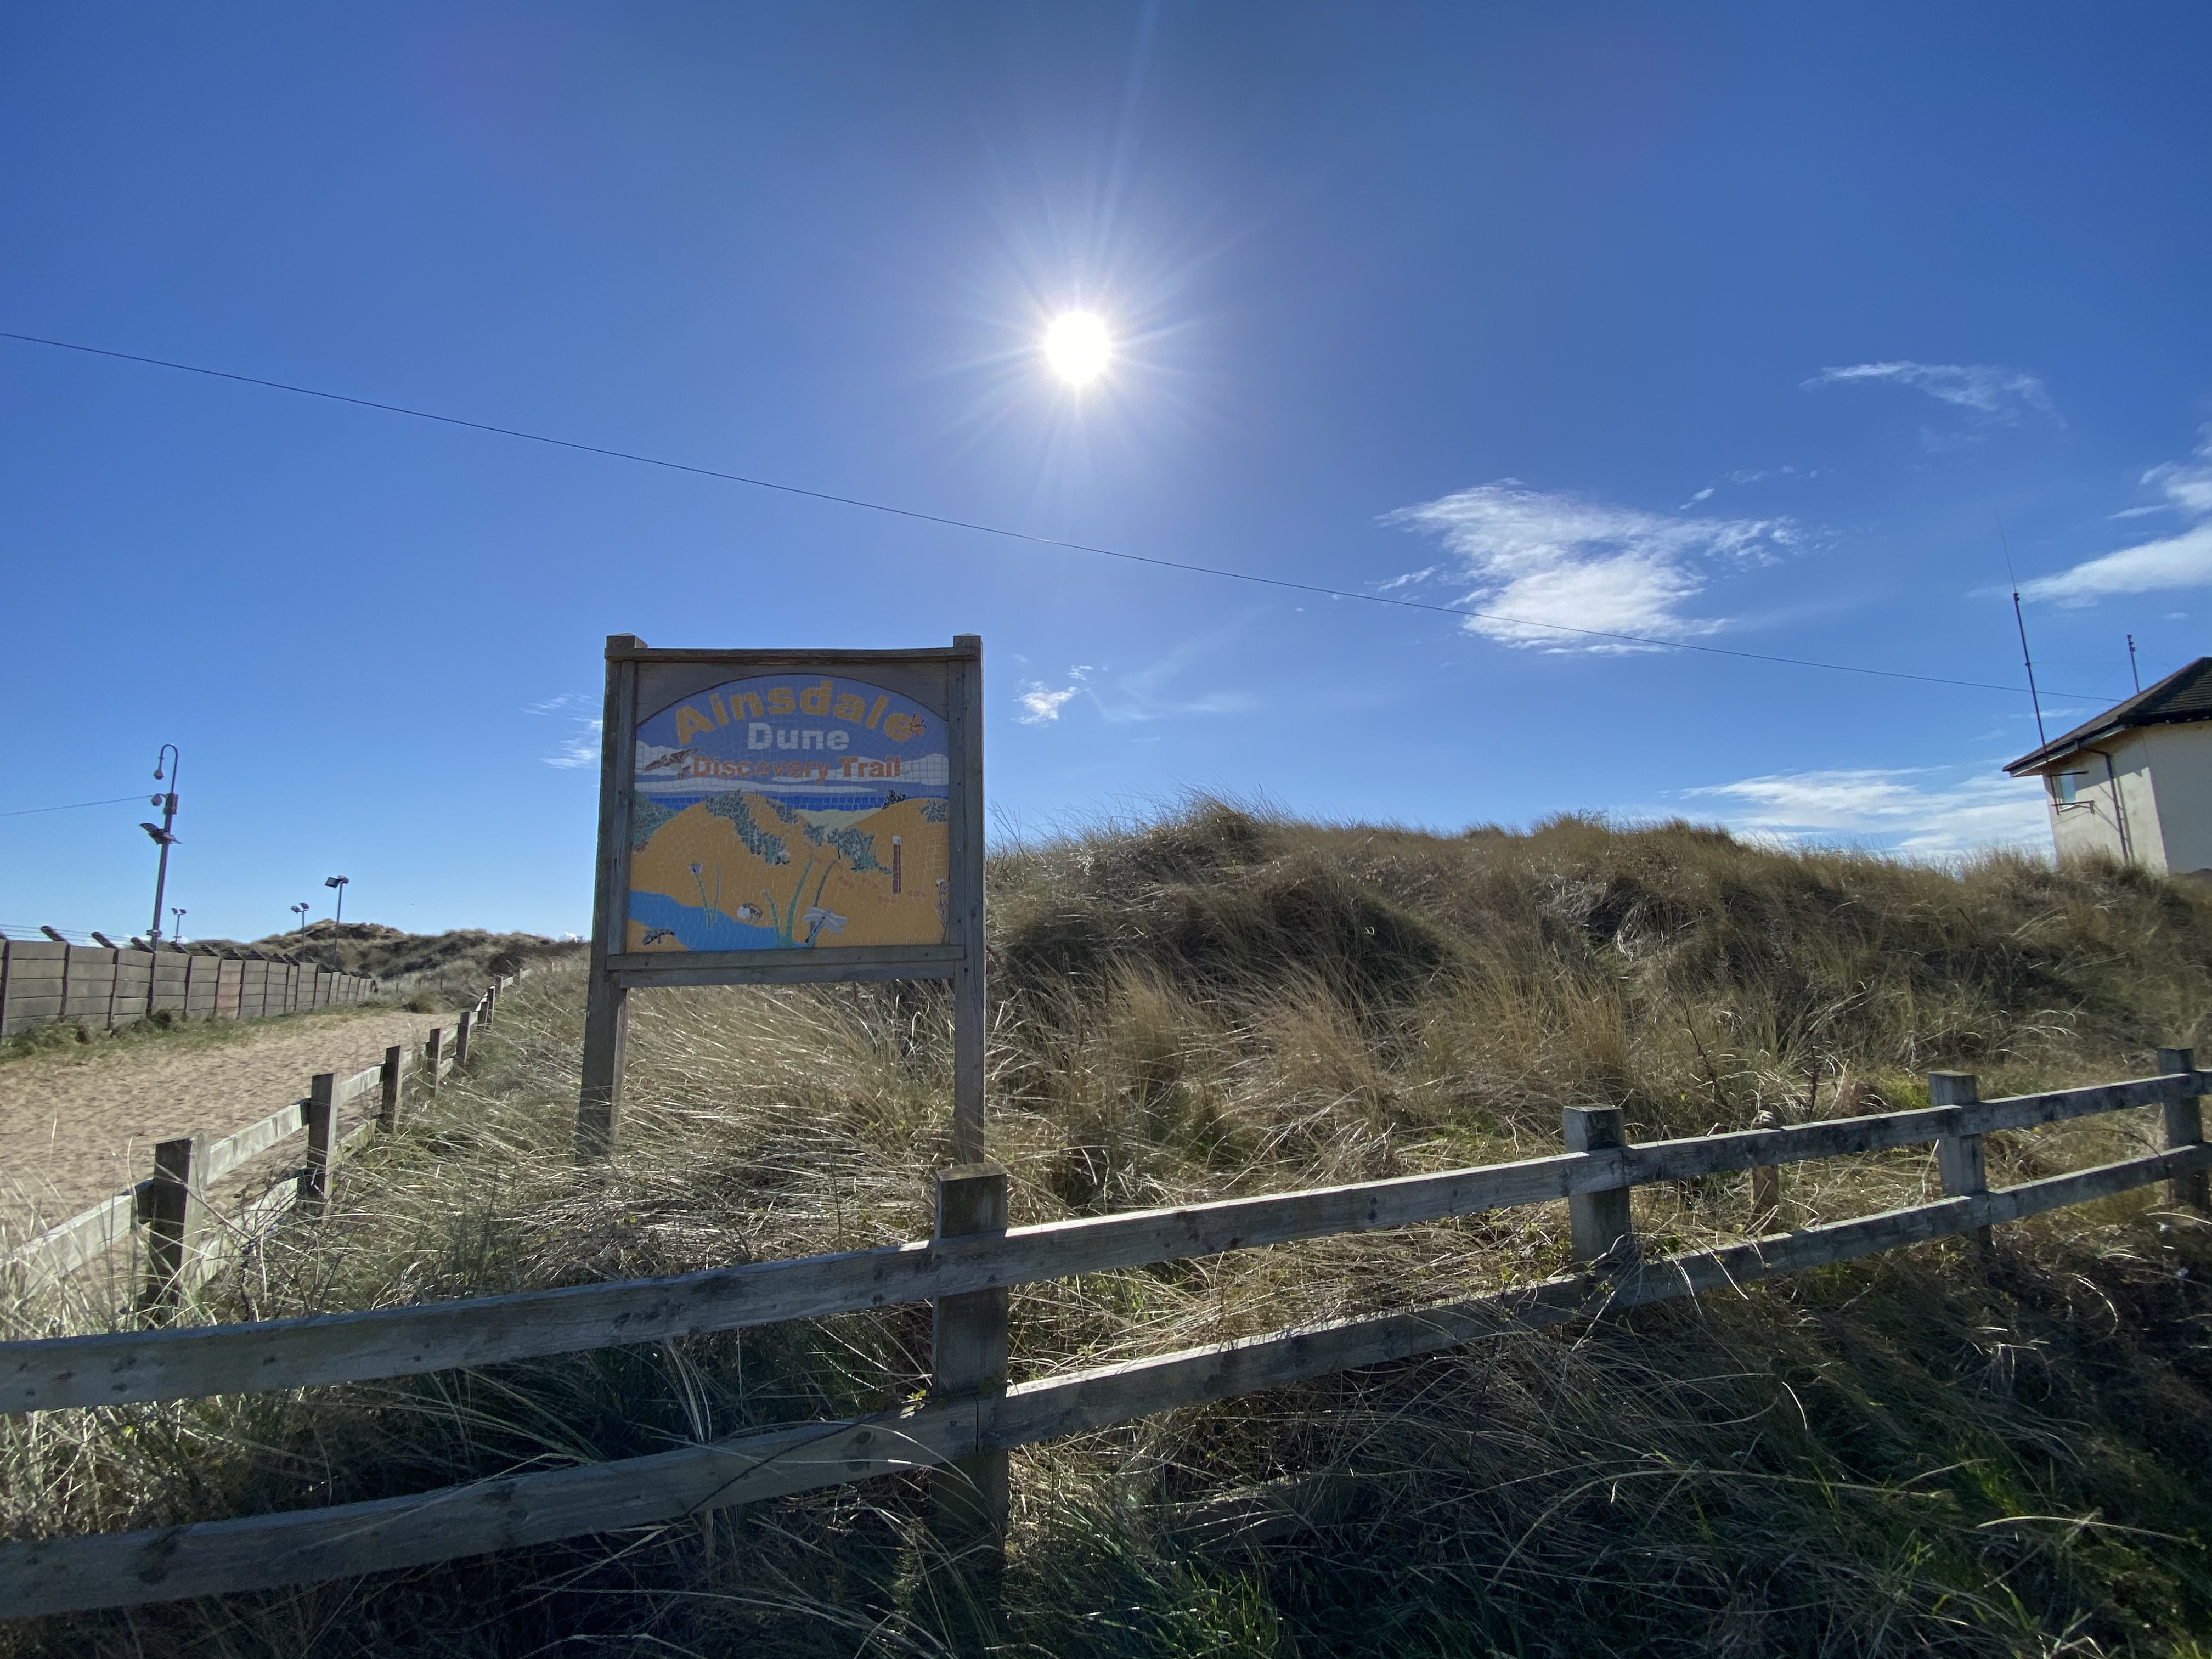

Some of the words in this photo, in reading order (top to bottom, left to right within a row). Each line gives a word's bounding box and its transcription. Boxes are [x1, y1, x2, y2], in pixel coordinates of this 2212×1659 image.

[676, 681, 915, 746] Ainsdale
[748, 722, 850, 751] Dune
[693, 756, 830, 783] Discovery
[839, 756, 901, 777] Trail
